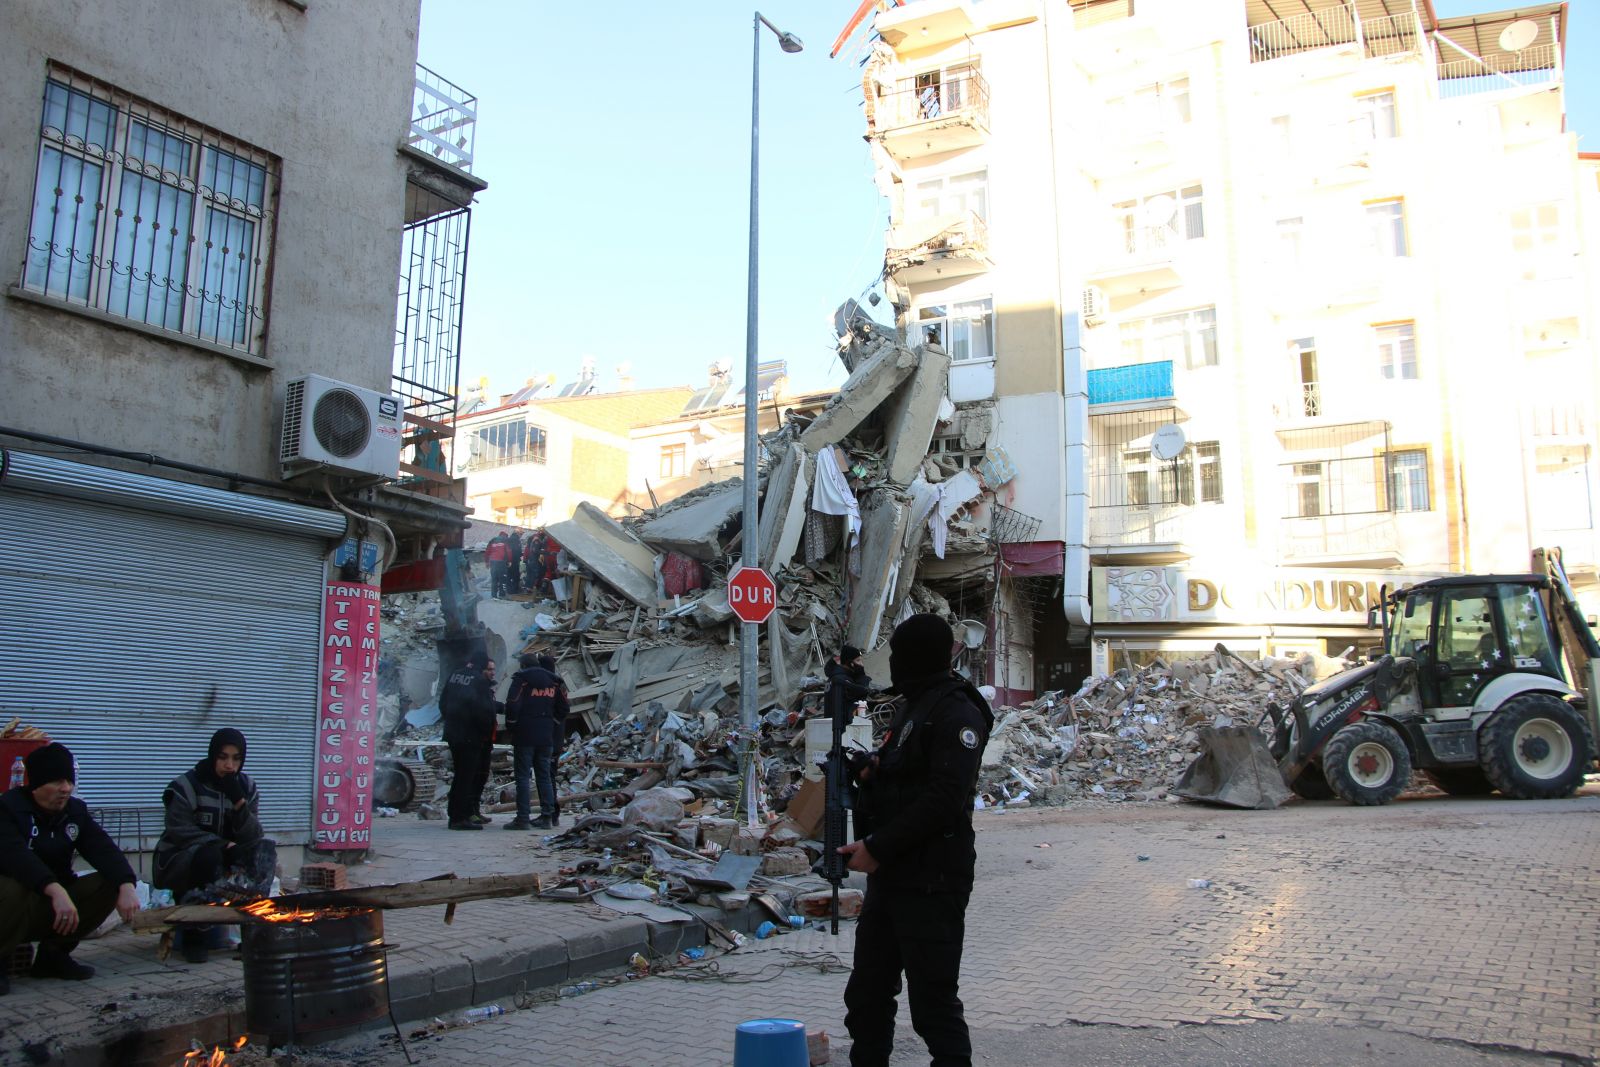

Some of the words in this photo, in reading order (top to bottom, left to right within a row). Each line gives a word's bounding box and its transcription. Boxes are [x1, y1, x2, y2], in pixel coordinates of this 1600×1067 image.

[327, 586, 360, 598] TAN
[363, 589, 380, 601] TAN
[732, 585, 772, 604] DUR
[1188, 578, 1412, 612] DNDURM
[530, 687, 556, 698] AFAD
[322, 754, 343, 764] ve
[321, 772, 340, 825] ÜTÜ
[354, 773, 368, 825] ÜTÜ
